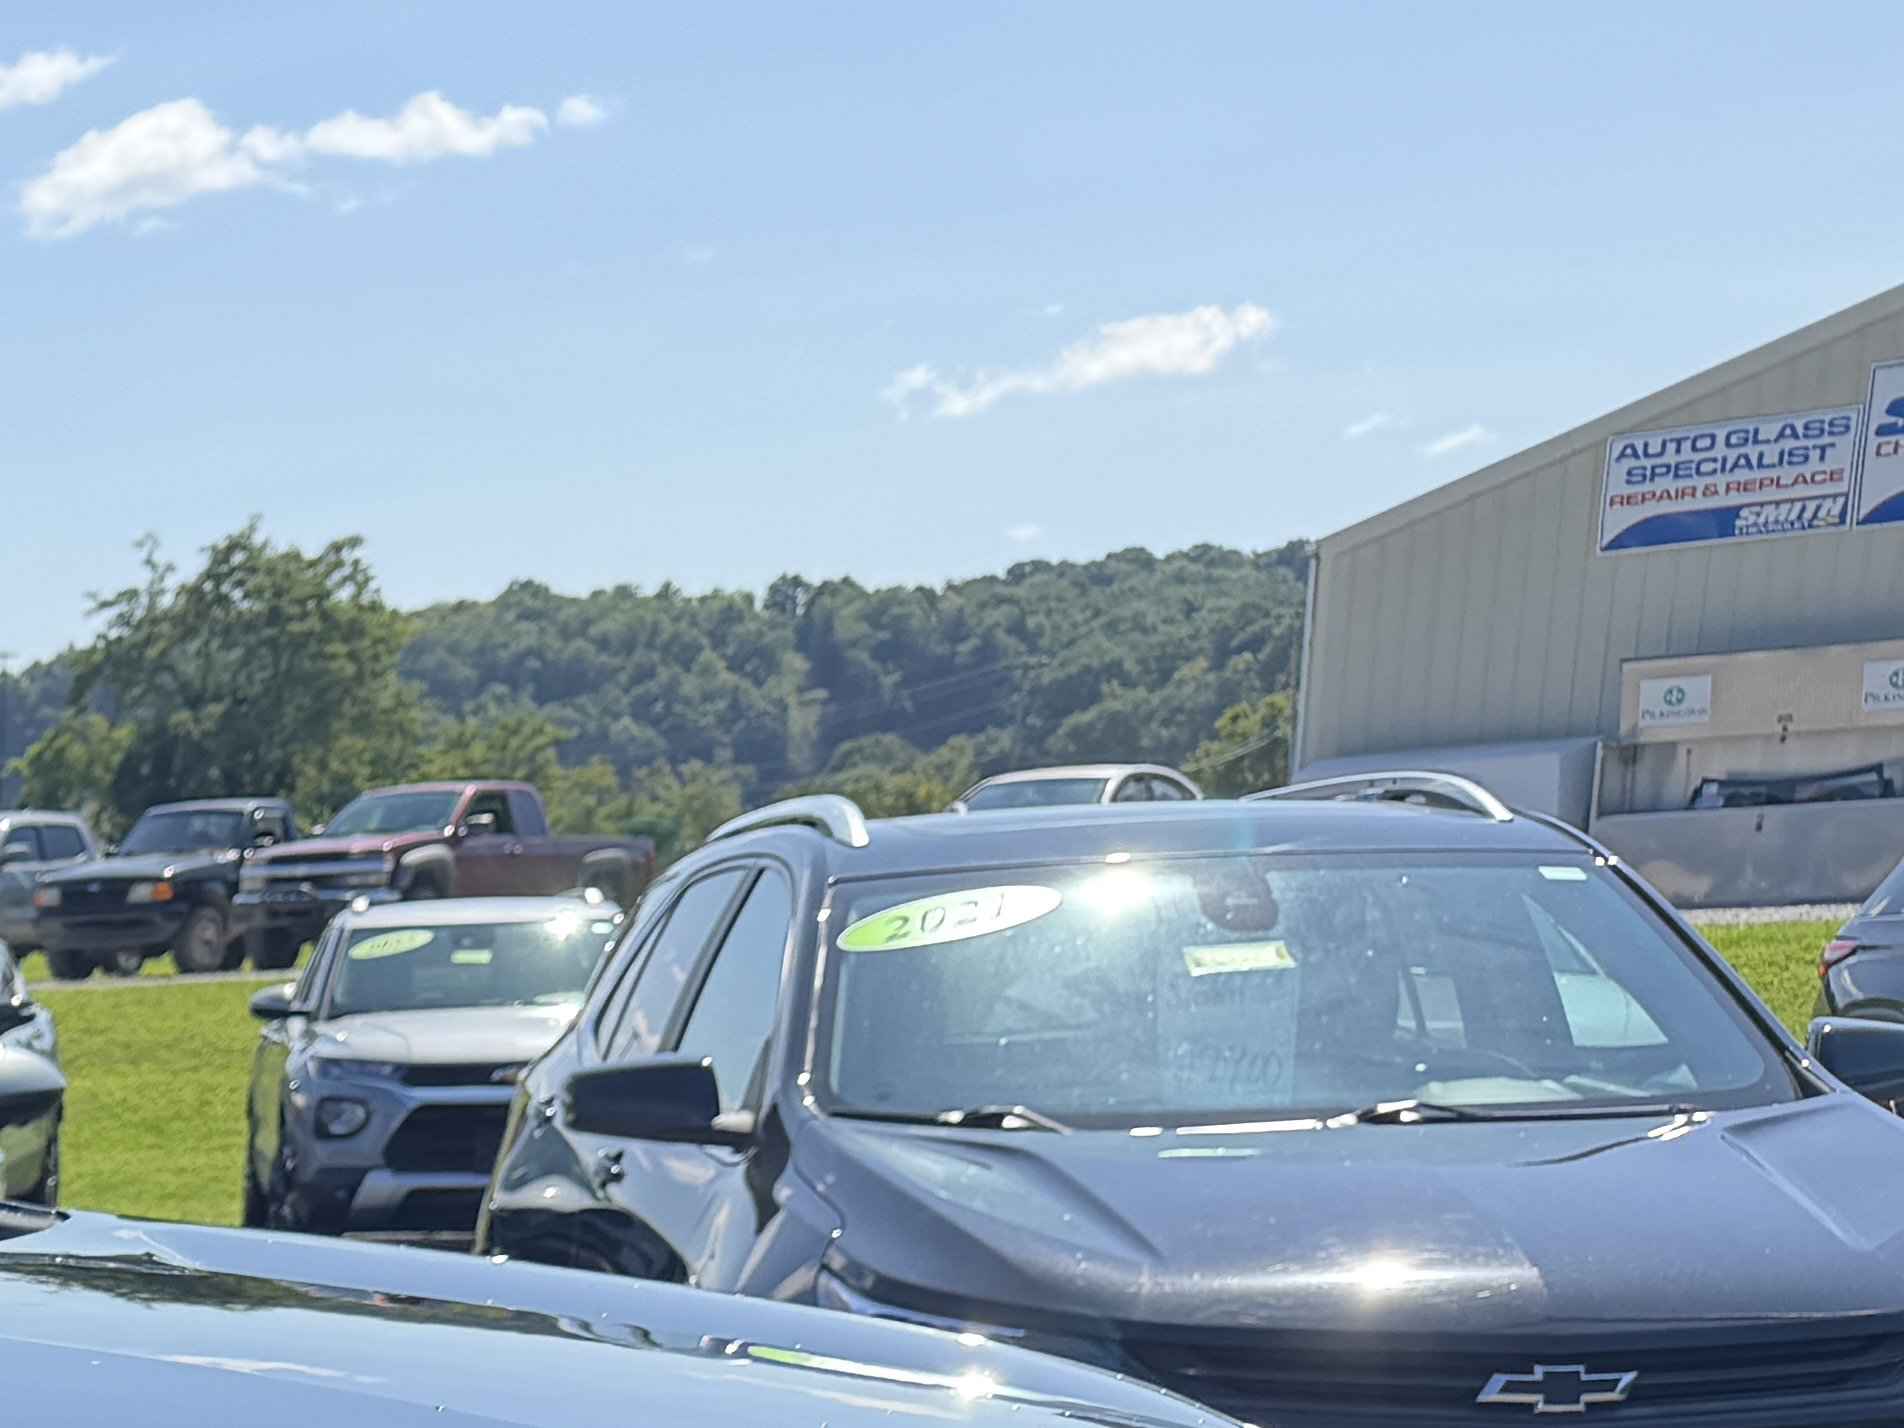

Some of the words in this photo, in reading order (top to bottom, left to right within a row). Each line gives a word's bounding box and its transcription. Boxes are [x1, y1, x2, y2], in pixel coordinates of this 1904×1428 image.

[1614, 432, 1717, 464] AUTO
[1724, 415, 1852, 449] GLASS
[1624, 442, 1837, 486] SPECIALIST
[1608, 484, 1697, 508] REPAIR
[1701, 482, 1721, 497] &
[1724, 467, 1845, 496] REPLACE
[1735, 495, 1846, 526] SMITH
